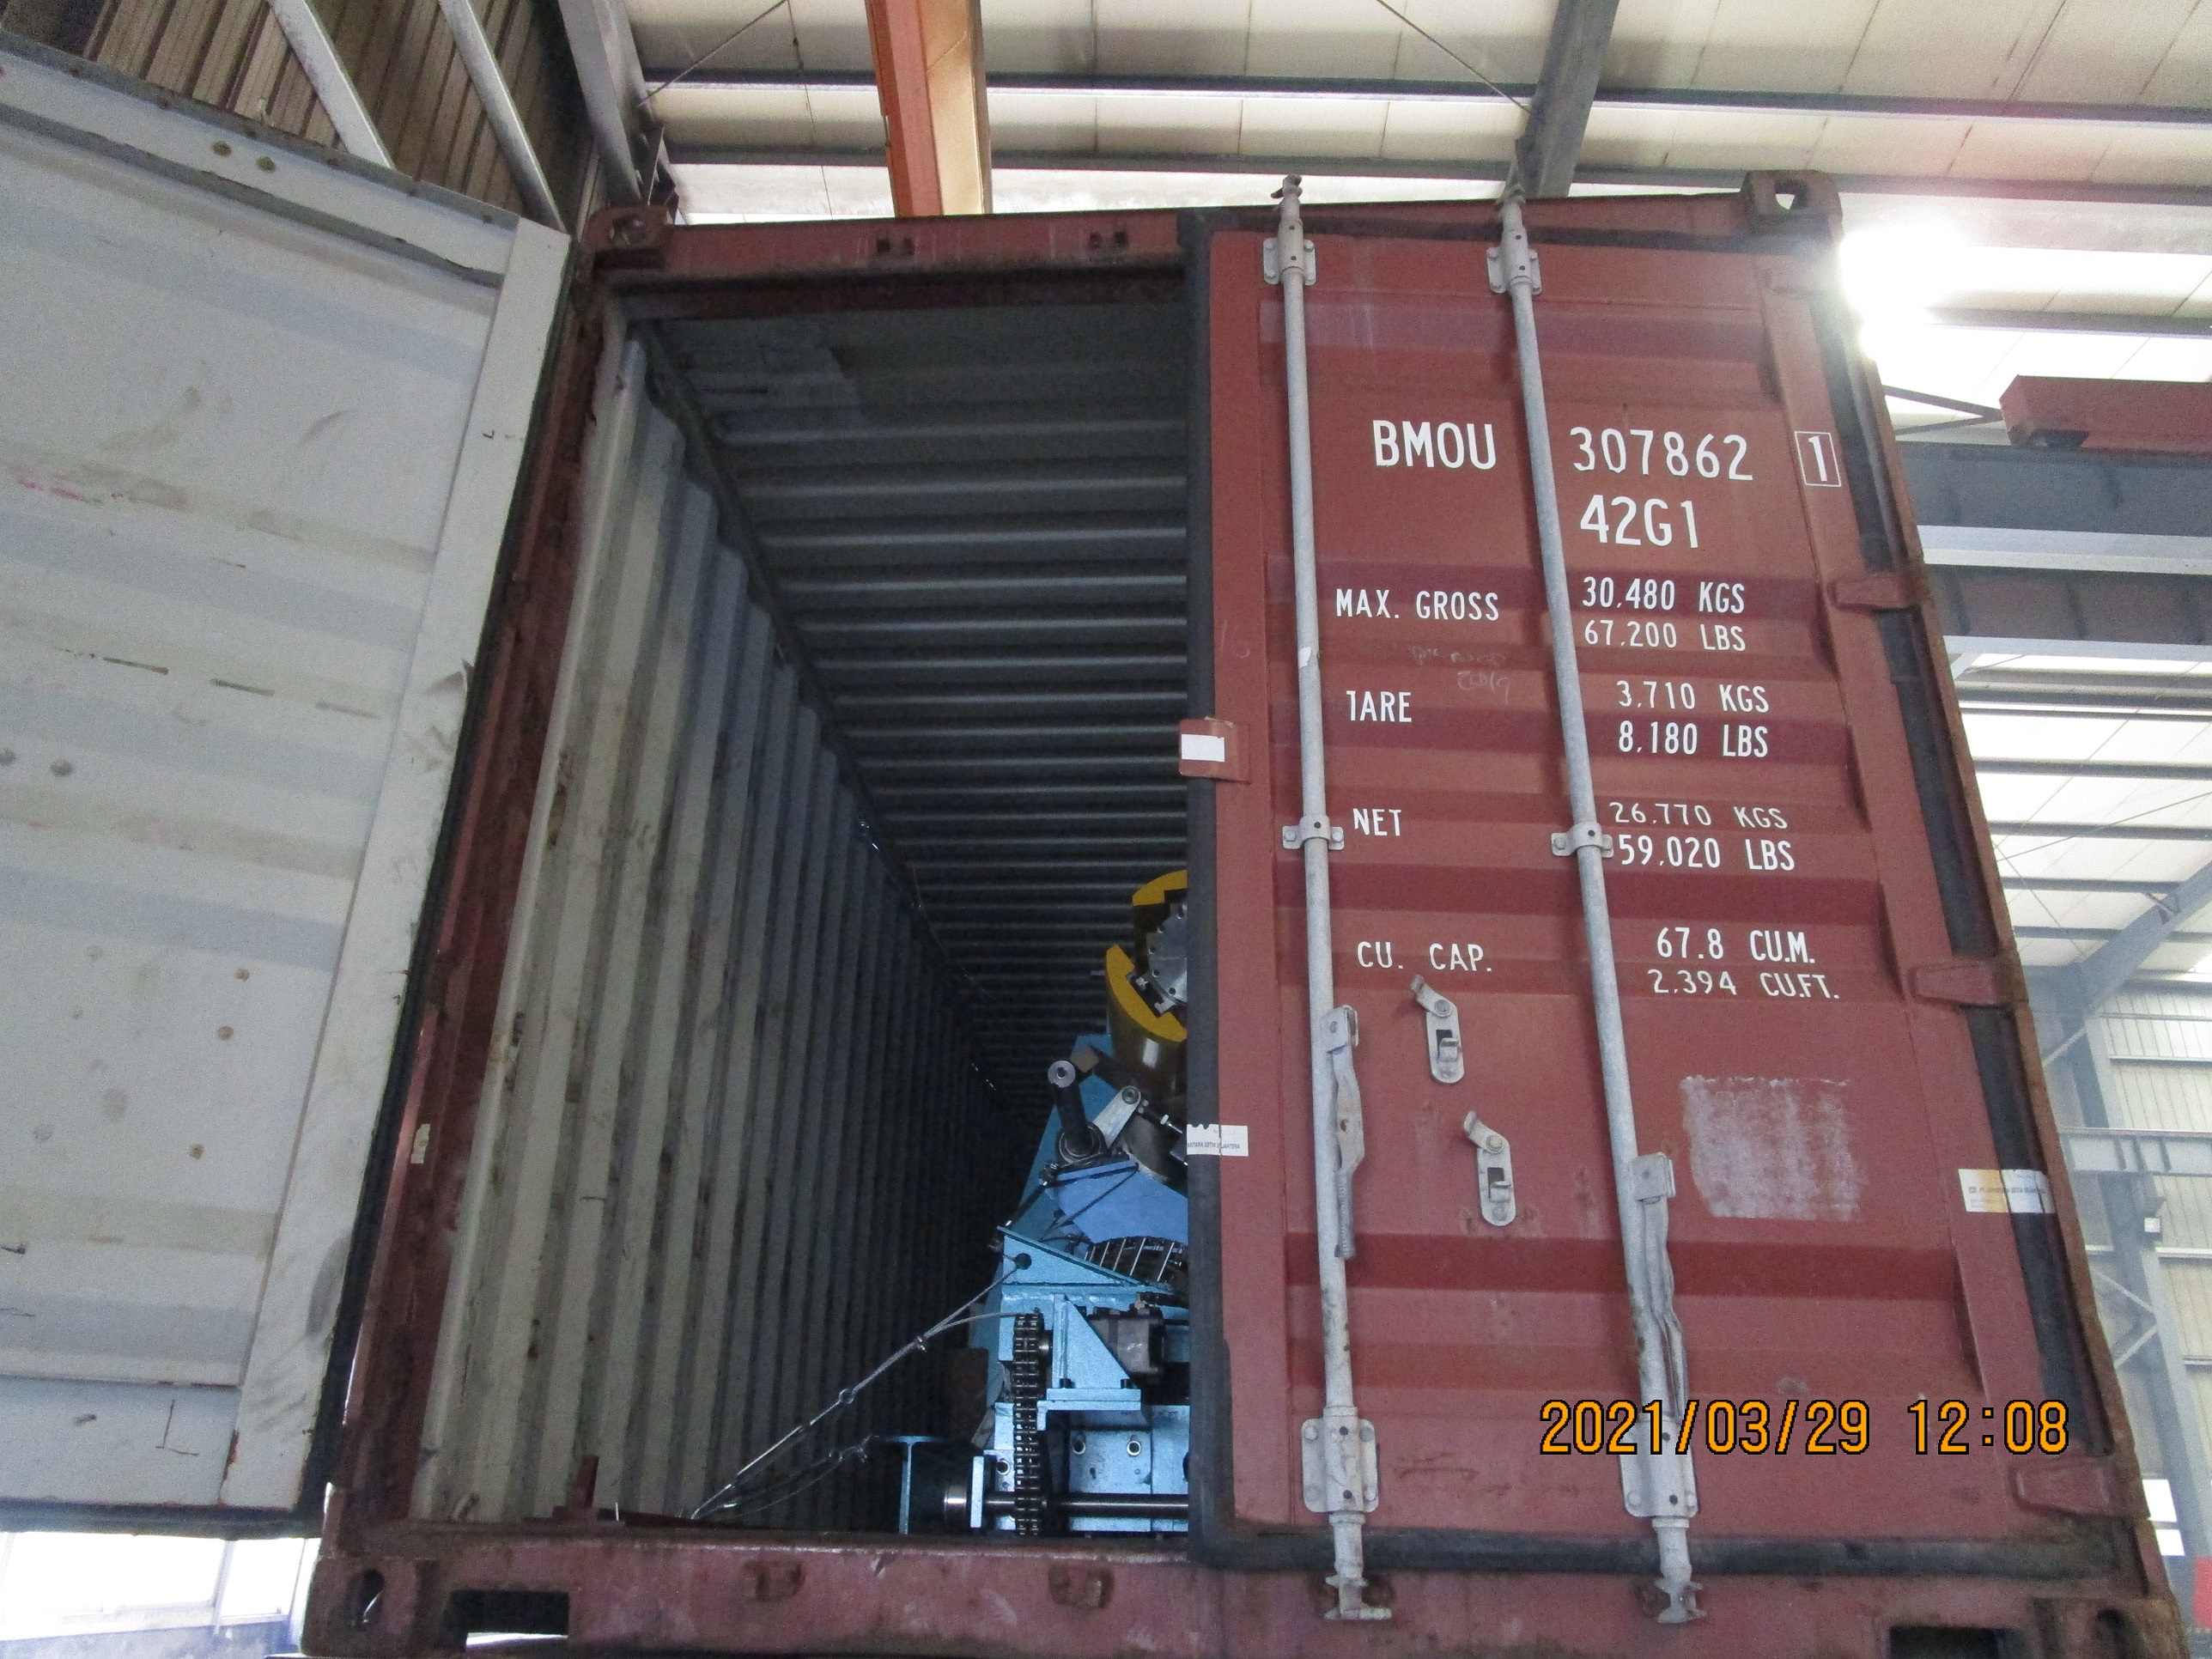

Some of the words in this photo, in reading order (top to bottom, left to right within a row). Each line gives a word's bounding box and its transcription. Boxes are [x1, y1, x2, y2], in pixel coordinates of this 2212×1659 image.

[1372, 419, 1497, 471] BMOU
[1570, 426, 1754, 482] 307862
[1579, 494, 1699, 549] 42G1
[1335, 588, 1400, 619] MAX.
[1415, 590, 1499, 622] GROSS
[1582, 575, 1675, 611] 30.480
[1698, 580, 1745, 614] KGS
[1584, 617, 1679, 648] 67.200
[1698, 623, 1747, 652] LBS
[1615, 679, 1696, 710] 3.710
[1718, 683, 1770, 714] KGS
[1619, 720, 1698, 755] 8.180
[1723, 724, 1768, 758] LBS
[1352, 807, 1402, 837] NET
[1733, 805, 1789, 830] KGS
[1618, 833, 1721, 869] 59.020
[1744, 838, 1796, 872] LBS
[1357, 940, 1404, 969] CU.
[1429, 943, 1492, 972] CAP.
[1656, 927, 1724, 960] 67.8
[1650, 969, 1737, 996] 2.394
